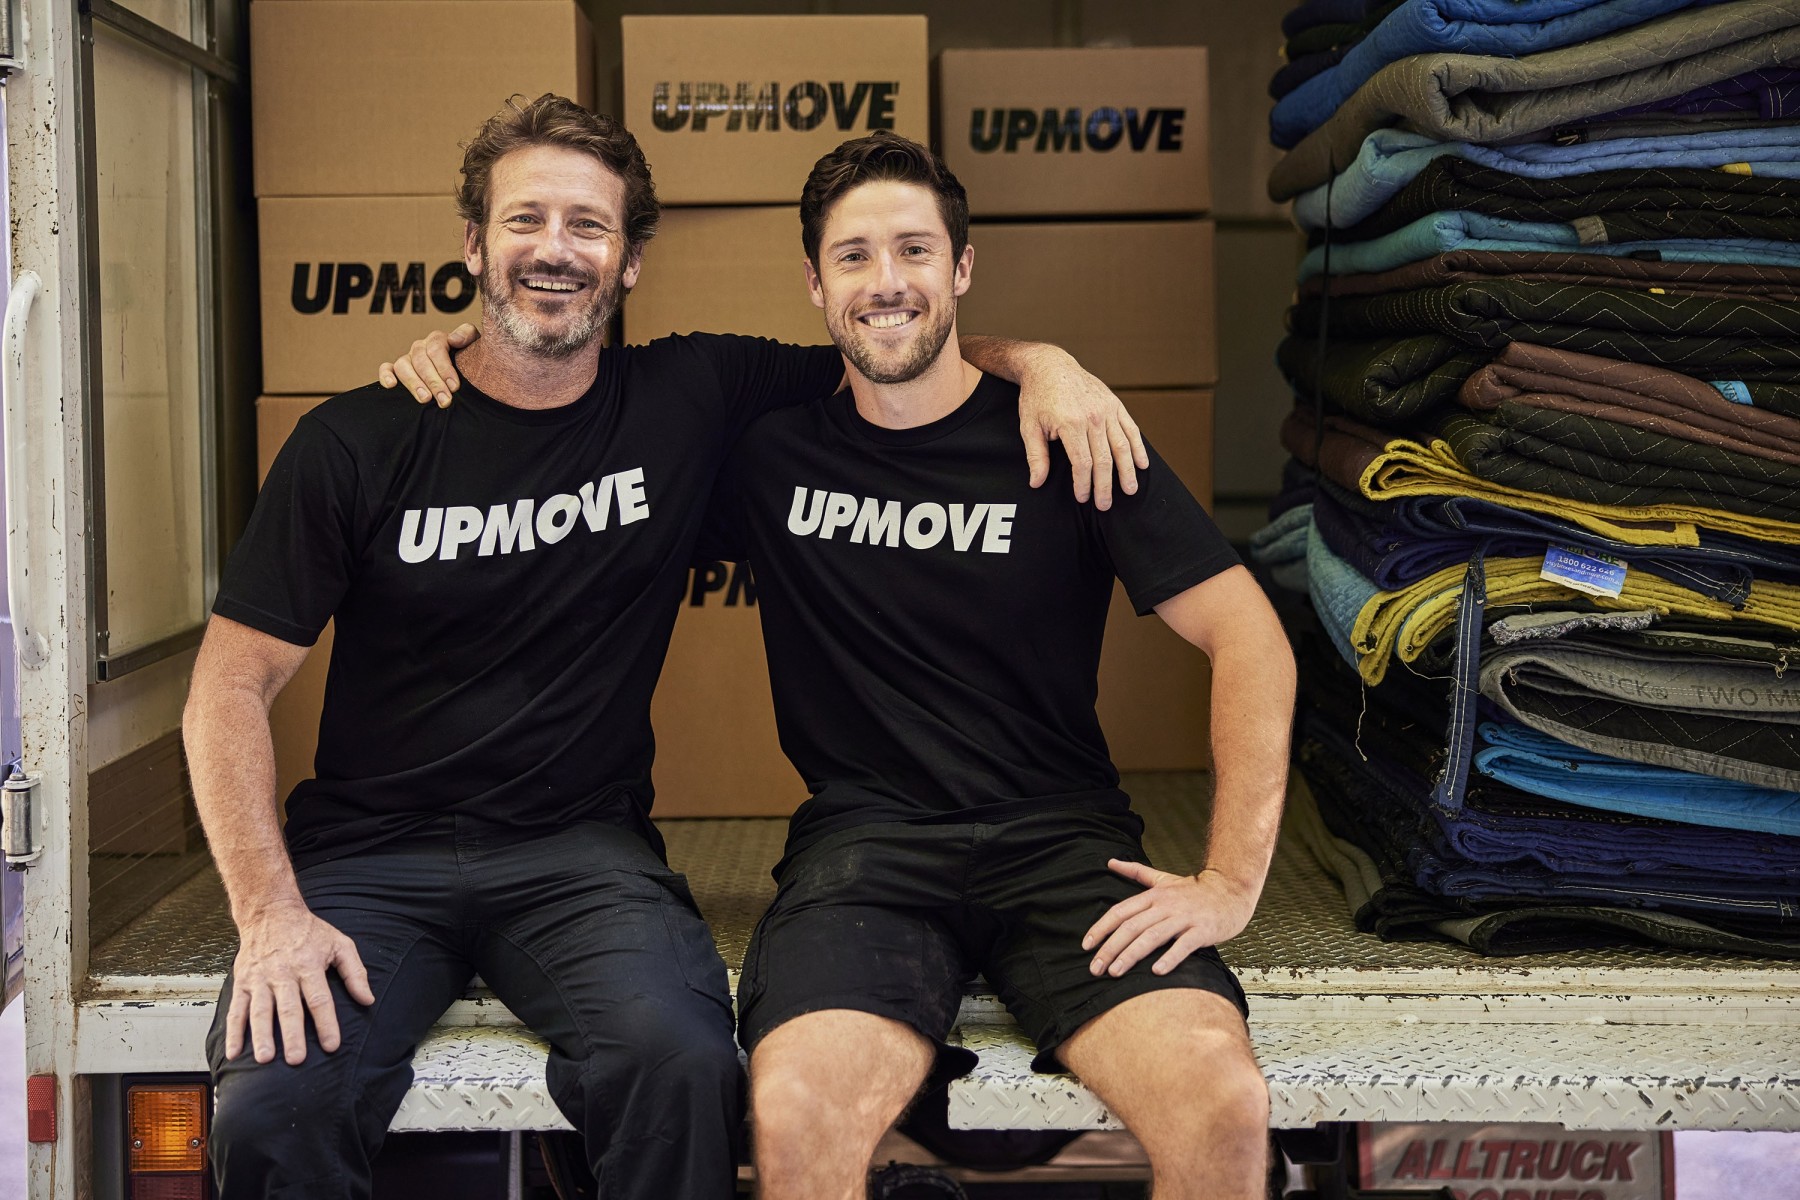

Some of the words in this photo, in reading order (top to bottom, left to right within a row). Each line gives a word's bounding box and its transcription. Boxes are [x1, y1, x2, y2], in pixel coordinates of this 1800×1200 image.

[651, 80, 900, 132] UPMOVE
[969, 107, 1187, 153] UPMOVE
[397, 467, 649, 563] UPMOVE
[787, 485, 1018, 554] UPMOVE
[680, 560, 758, 607] PM
[1557, 555, 1580, 567] 1800
[1580, 562, 1597, 572] 622
[1691, 684, 1760, 708] TWO
[1392, 1138, 1642, 1182] ALLTRUCK
